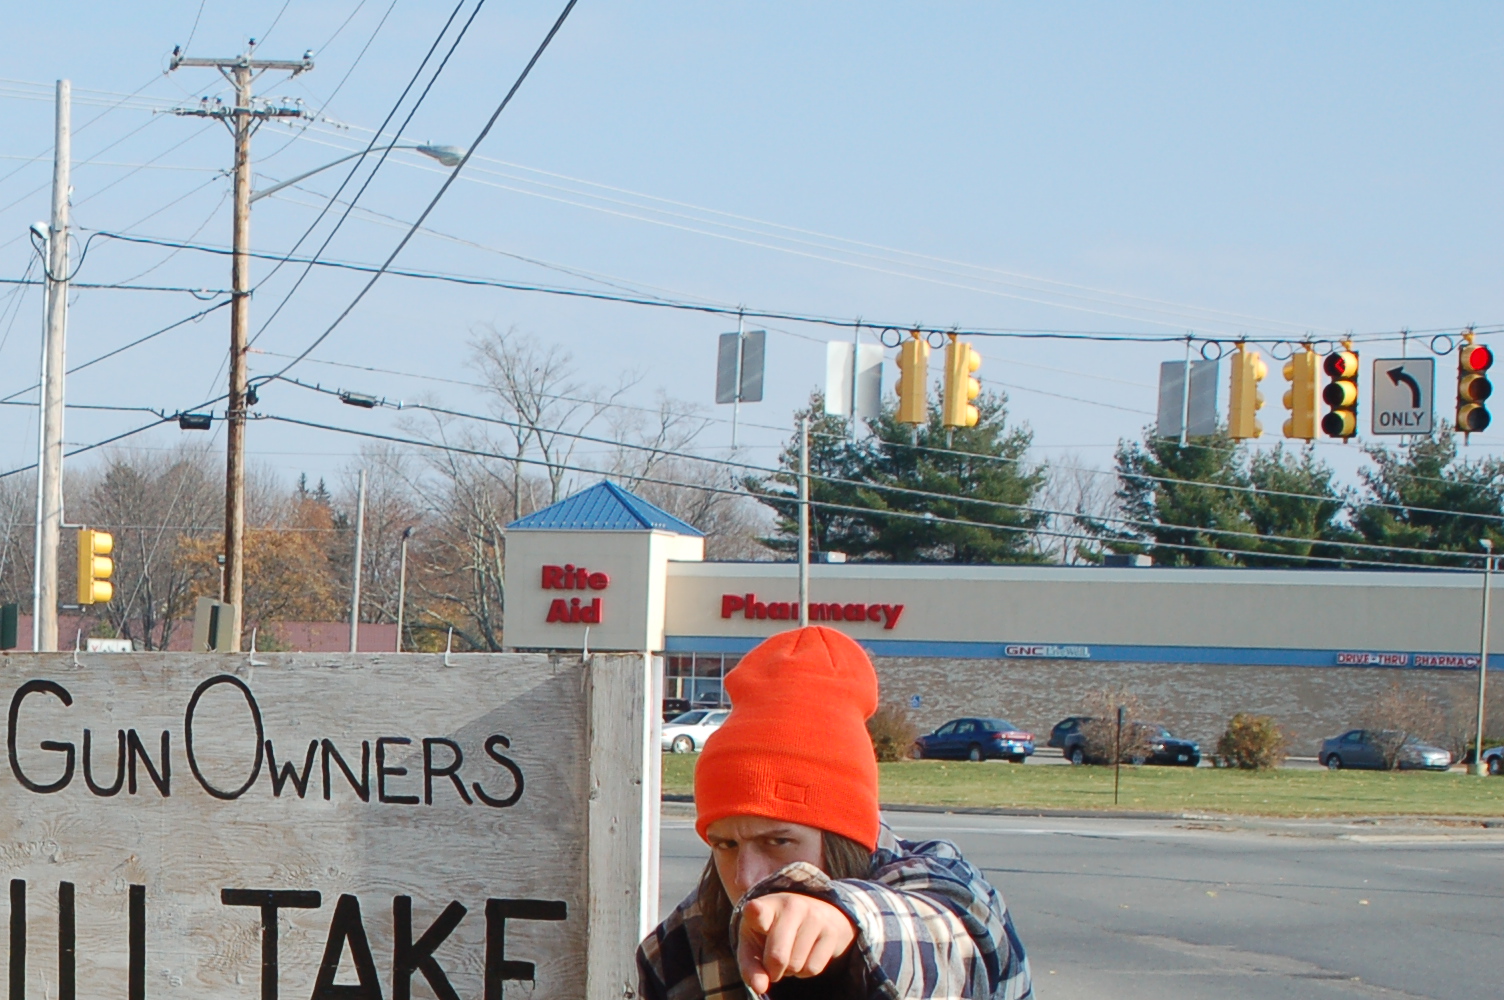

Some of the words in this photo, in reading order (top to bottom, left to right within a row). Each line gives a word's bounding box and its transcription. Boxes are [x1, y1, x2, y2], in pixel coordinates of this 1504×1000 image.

[1380, 411, 1425, 426] ONLY
[541, 563, 610, 590] Rite
[546, 597, 603, 624] Aid
[721, 593, 905, 630] Pharmacy
[1006, 646, 1043, 656] GNC
[1414, 655, 1481, 668] PHARMACY
[7, 680, 171, 798] GUN
[185, 675, 525, 808] OWNERS
